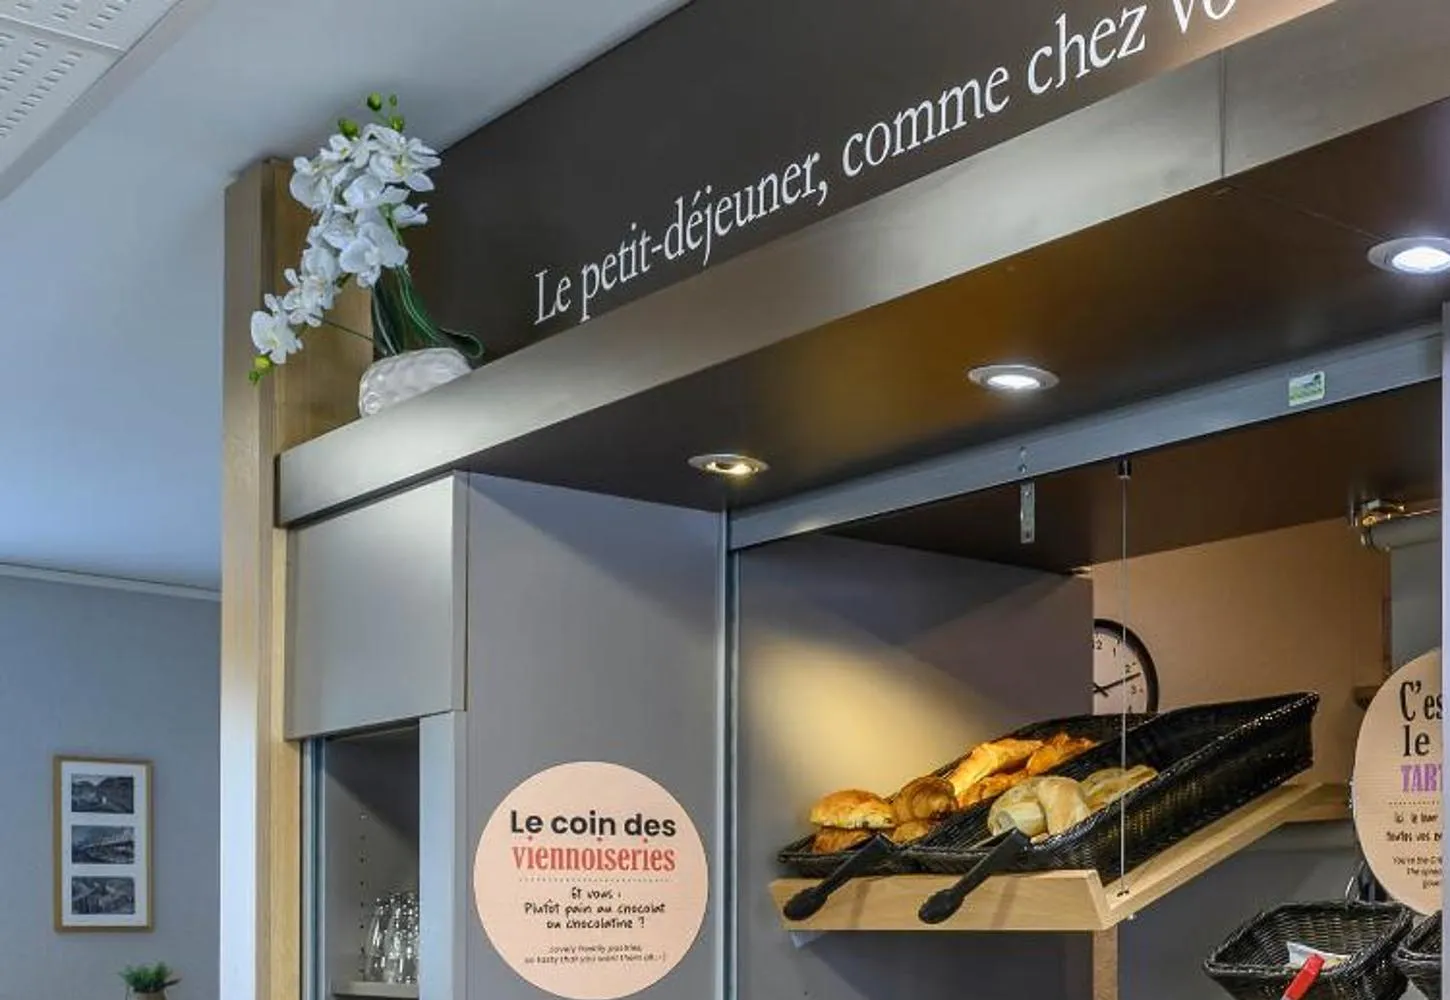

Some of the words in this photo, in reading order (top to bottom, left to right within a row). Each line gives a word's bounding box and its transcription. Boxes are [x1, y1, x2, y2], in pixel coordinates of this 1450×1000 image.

[534, 269, 571, 325] Le
[580, 152, 828, 322] petit-déjeuner,
[842, 66, 1009, 177] comme
[1027, 4, 1147, 95] chez
[1402, 724, 1430, 757] le
[1401, 763, 1443, 793] TAR
[510, 809, 544, 834] Le
[551, 810, 616, 837] coin
[624, 813, 676, 838] des
[511, 835, 676, 873] viennoiseries
[571, 886, 582, 899] Et
[587, 889, 613, 899] vous
[524, 899, 560, 914] Plutôt
[565, 903, 592, 918] pain
[596, 905, 612, 914] au
[618, 903, 666, 914] chocolat
[546, 920, 561, 929] ou
[566, 917, 633, 929] chocolatine
